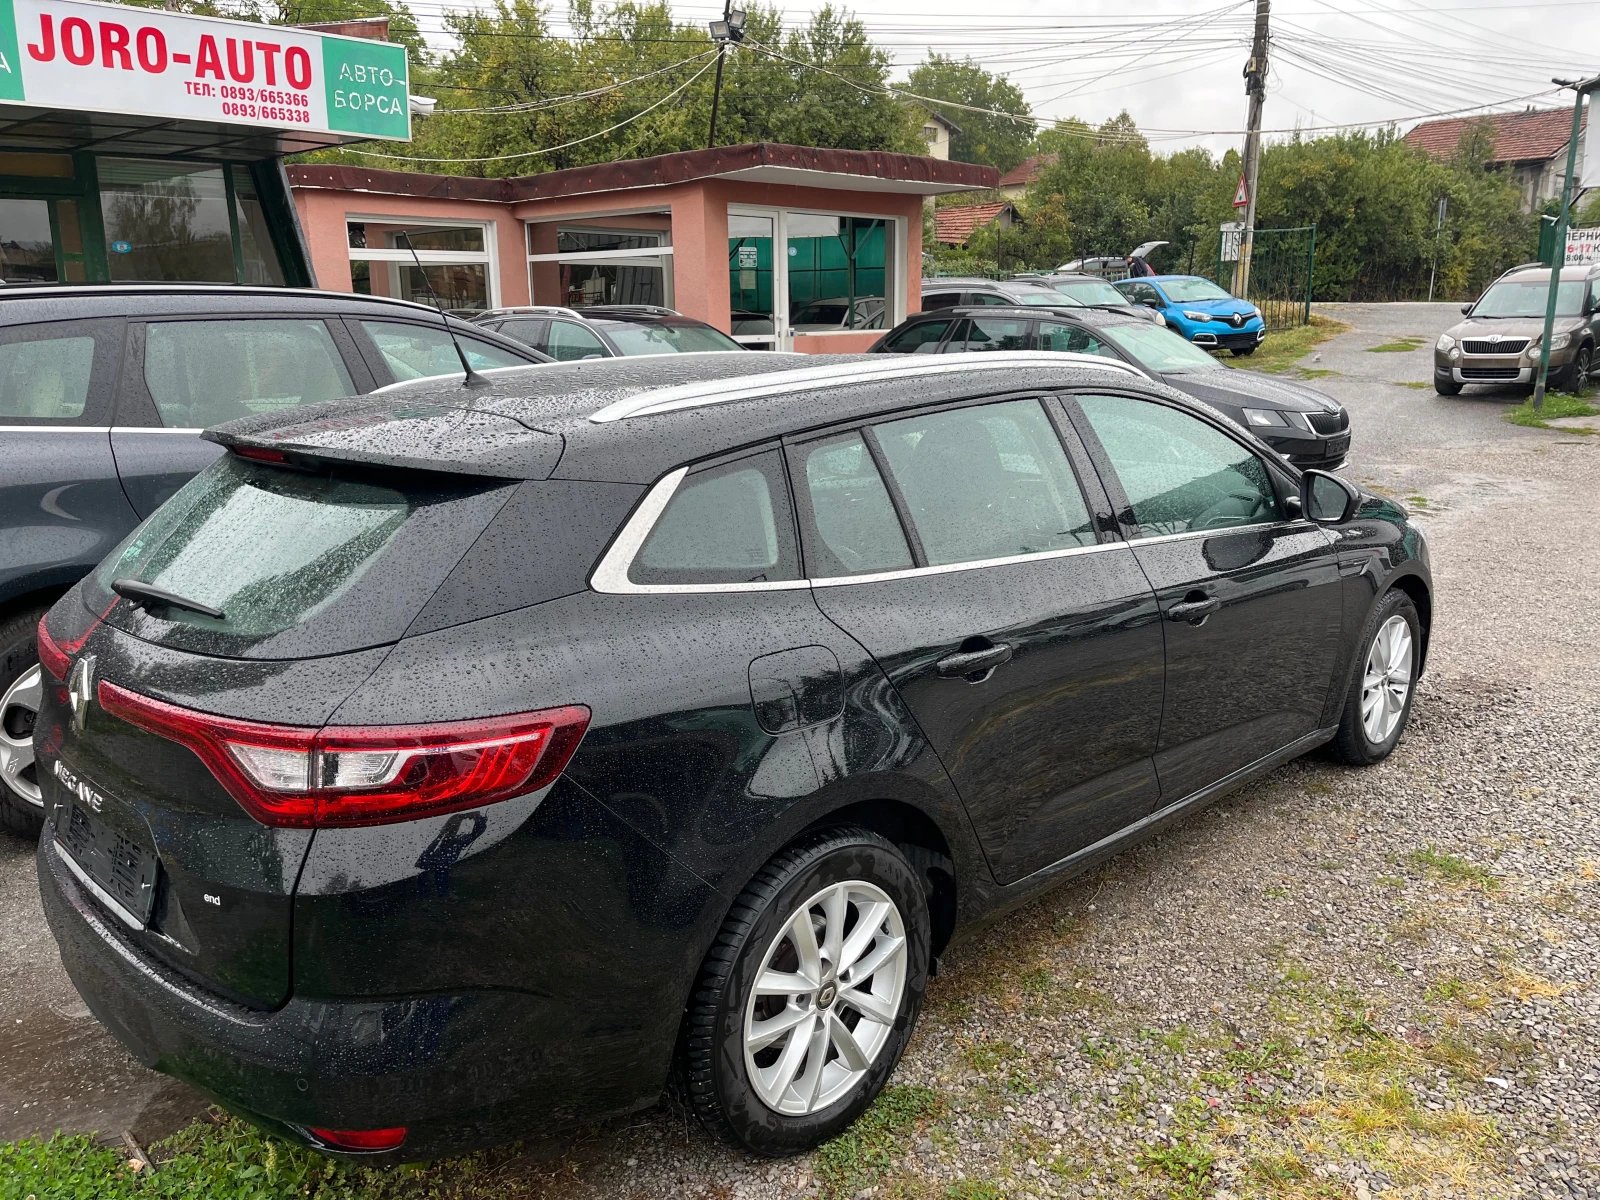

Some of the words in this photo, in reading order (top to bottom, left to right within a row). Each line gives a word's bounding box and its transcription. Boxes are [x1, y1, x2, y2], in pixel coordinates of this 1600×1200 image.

[27, 13, 313, 91] JORO-AUTO
[184, 81, 217, 98] ТЕЛ:
[220, 85, 310, 108] 0893/665366
[334, 89, 404, 117] БОРСА
[222, 101, 311, 124] 0893/665338
